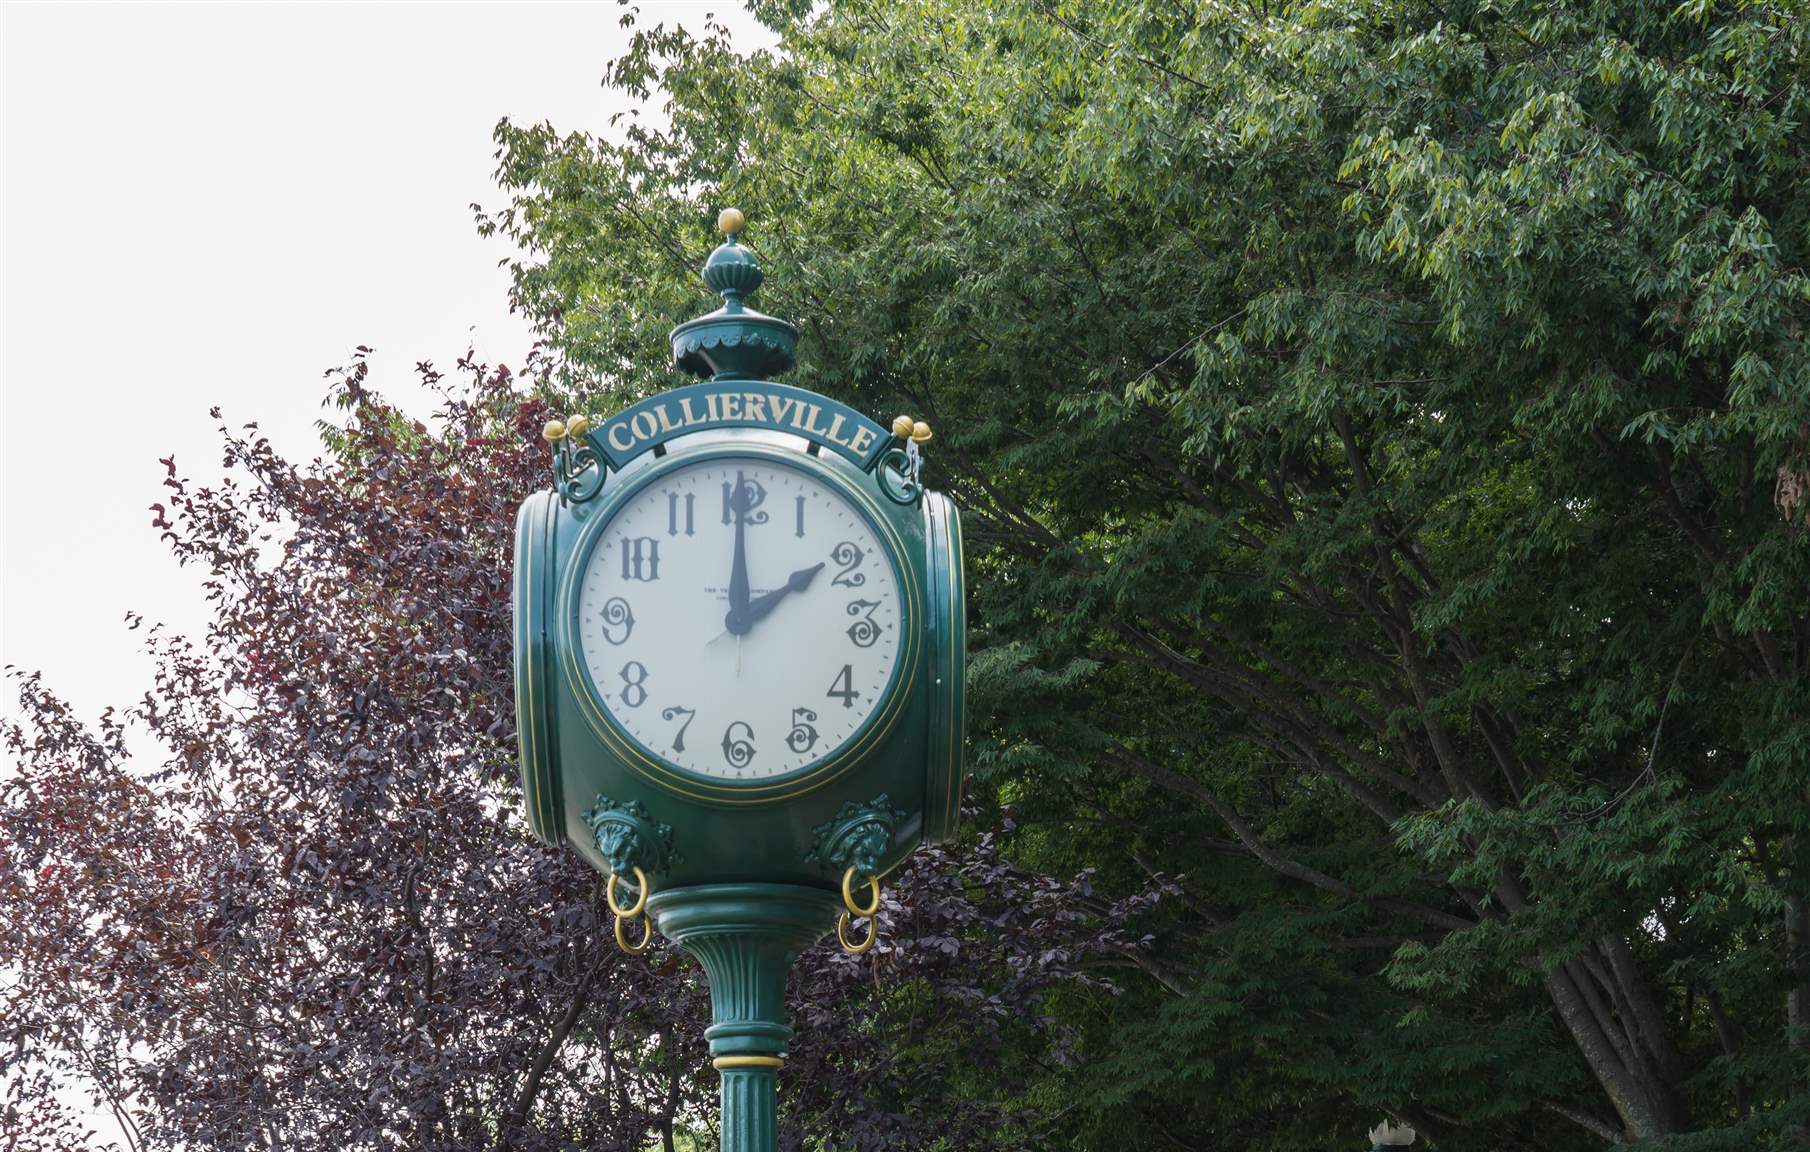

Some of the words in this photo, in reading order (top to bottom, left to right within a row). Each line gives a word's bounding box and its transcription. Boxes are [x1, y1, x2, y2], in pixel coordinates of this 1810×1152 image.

[608, 393, 878, 457] COLLIERVILLE
[667, 491, 695, 537] 11
[721, 479, 769, 525] 12
[795, 495, 806, 539] 1
[620, 536, 661, 582] 10
[830, 541, 866, 587] 2
[600, 596, 636, 645] 9
[845, 598, 883, 648] 3
[618, 661, 649, 708] 8
[826, 663, 861, 709] 4
[662, 705, 696, 753] 7
[720, 721, 757, 769] 6
[785, 707, 820, 753] 5
